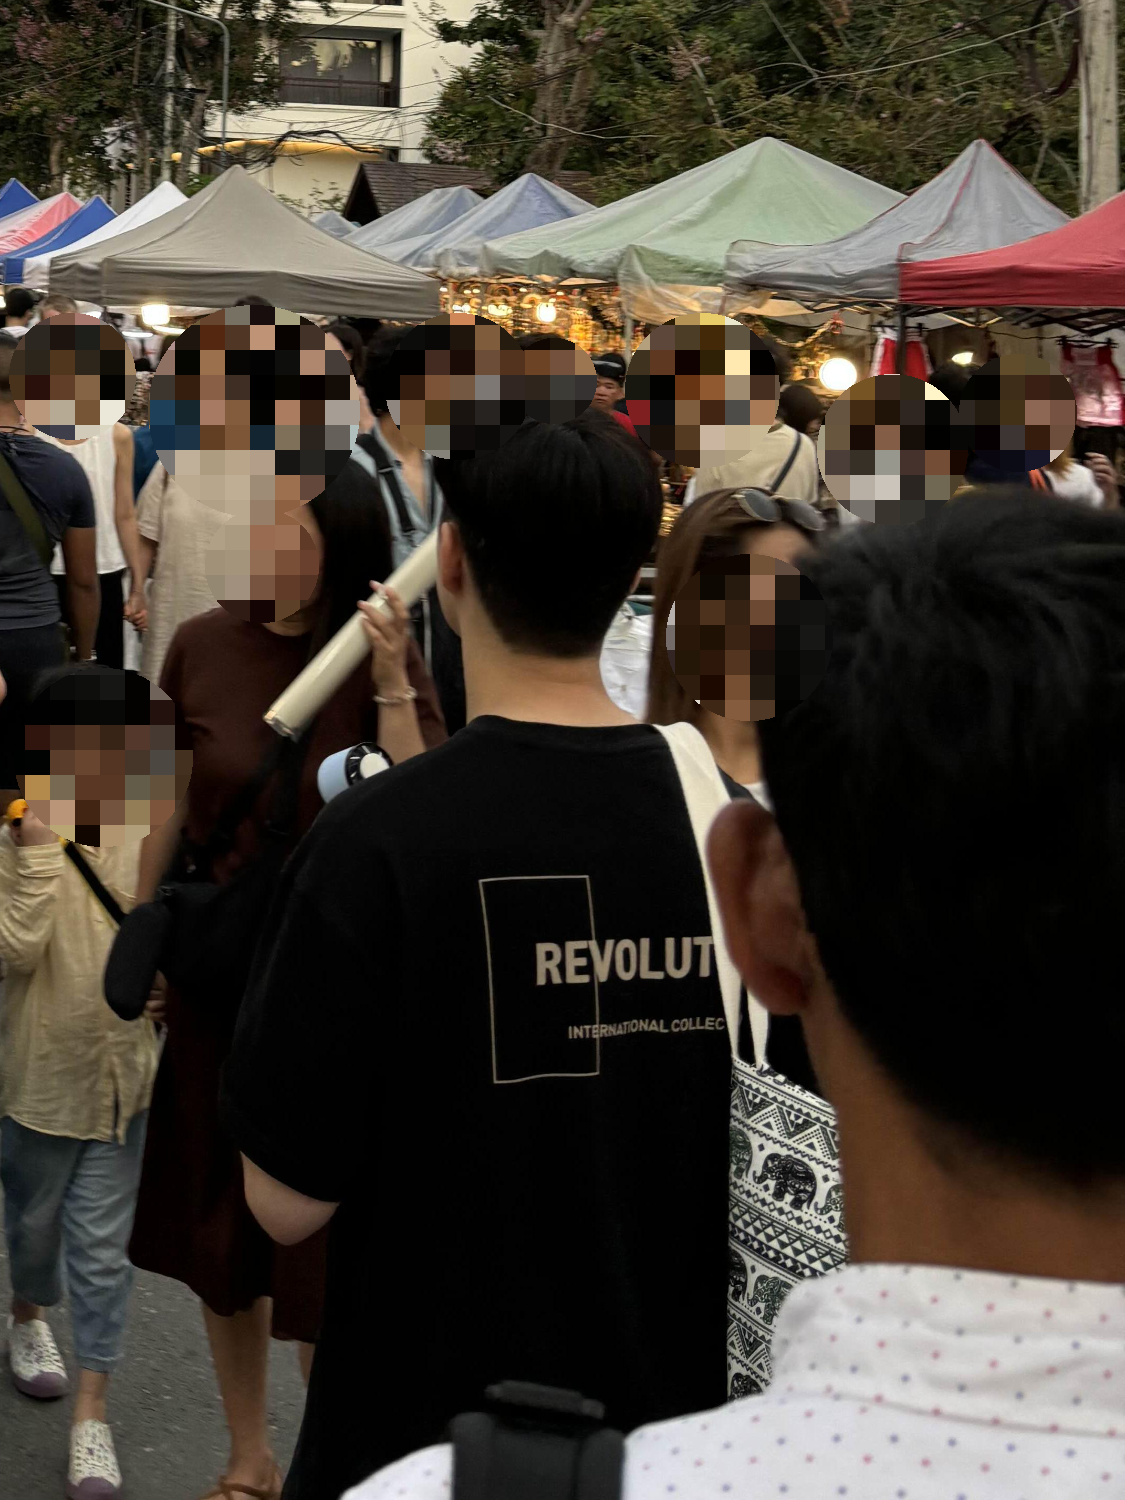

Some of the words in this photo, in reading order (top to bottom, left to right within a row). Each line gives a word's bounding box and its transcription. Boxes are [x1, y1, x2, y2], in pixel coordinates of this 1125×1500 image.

[535, 936, 714, 986] REVOLUT
[568, 1018, 669, 1039] INTERNATIONAL
[671, 1017, 725, 1033] COLLEC
